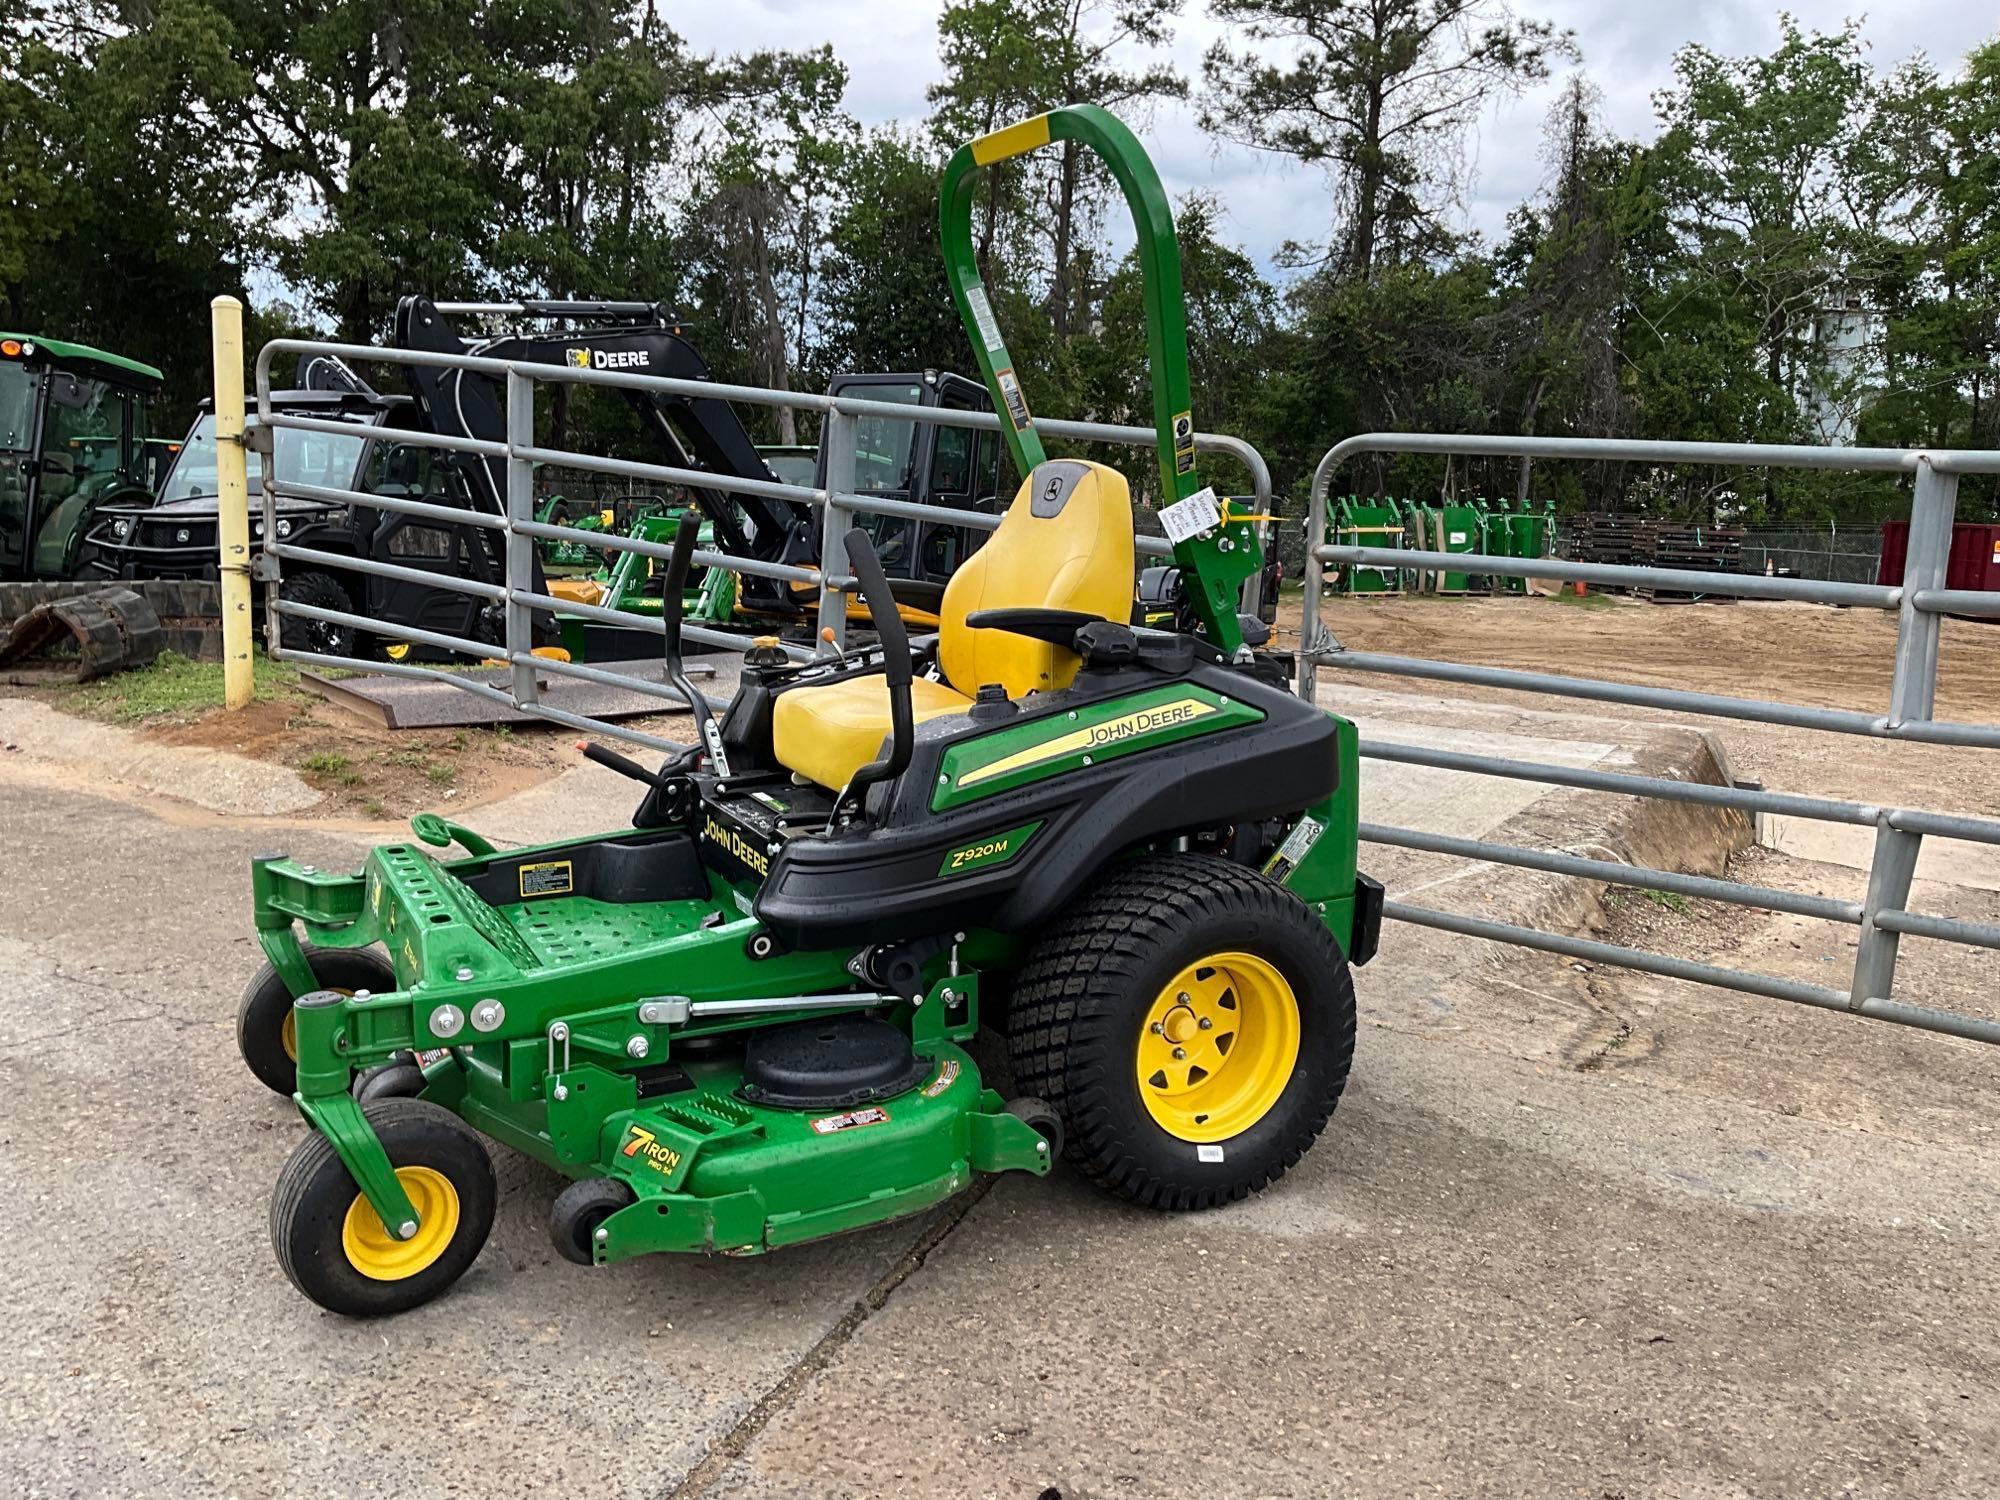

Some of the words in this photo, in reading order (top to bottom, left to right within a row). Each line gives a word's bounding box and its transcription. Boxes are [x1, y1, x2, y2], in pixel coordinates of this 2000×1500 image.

[594, 350, 650, 369] DEERE
[1086, 721, 1134, 746] JOHN
[1136, 704, 1194, 730] DEERE
[704, 814, 731, 851] JOHN
[732, 832, 769, 877] DEERE
[951, 840, 1008, 868] Z920M
[647, 1159, 662, 1171] PRO
